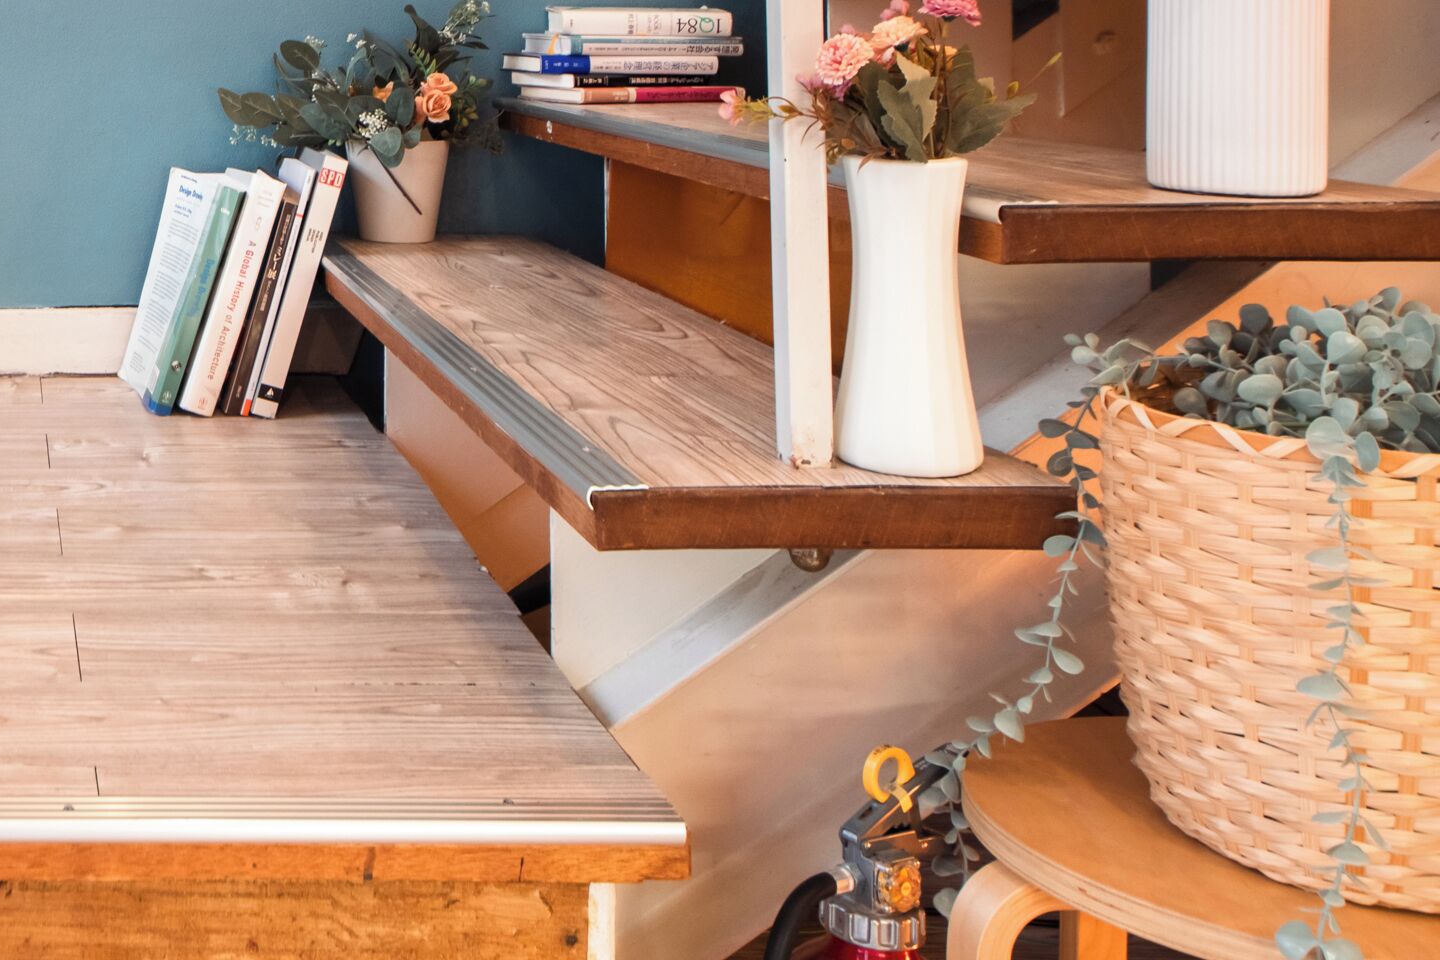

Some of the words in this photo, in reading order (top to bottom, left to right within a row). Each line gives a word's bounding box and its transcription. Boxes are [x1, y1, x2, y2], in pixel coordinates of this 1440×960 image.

[677, 15, 722, 34] 1Q84
[320, 168, 343, 188] SPD
[248, 239, 257, 247] A
[241, 249, 254, 278] Global
[227, 281, 246, 312] History
[225, 314, 233, 324] of
[207, 326, 230, 381] Architecture
